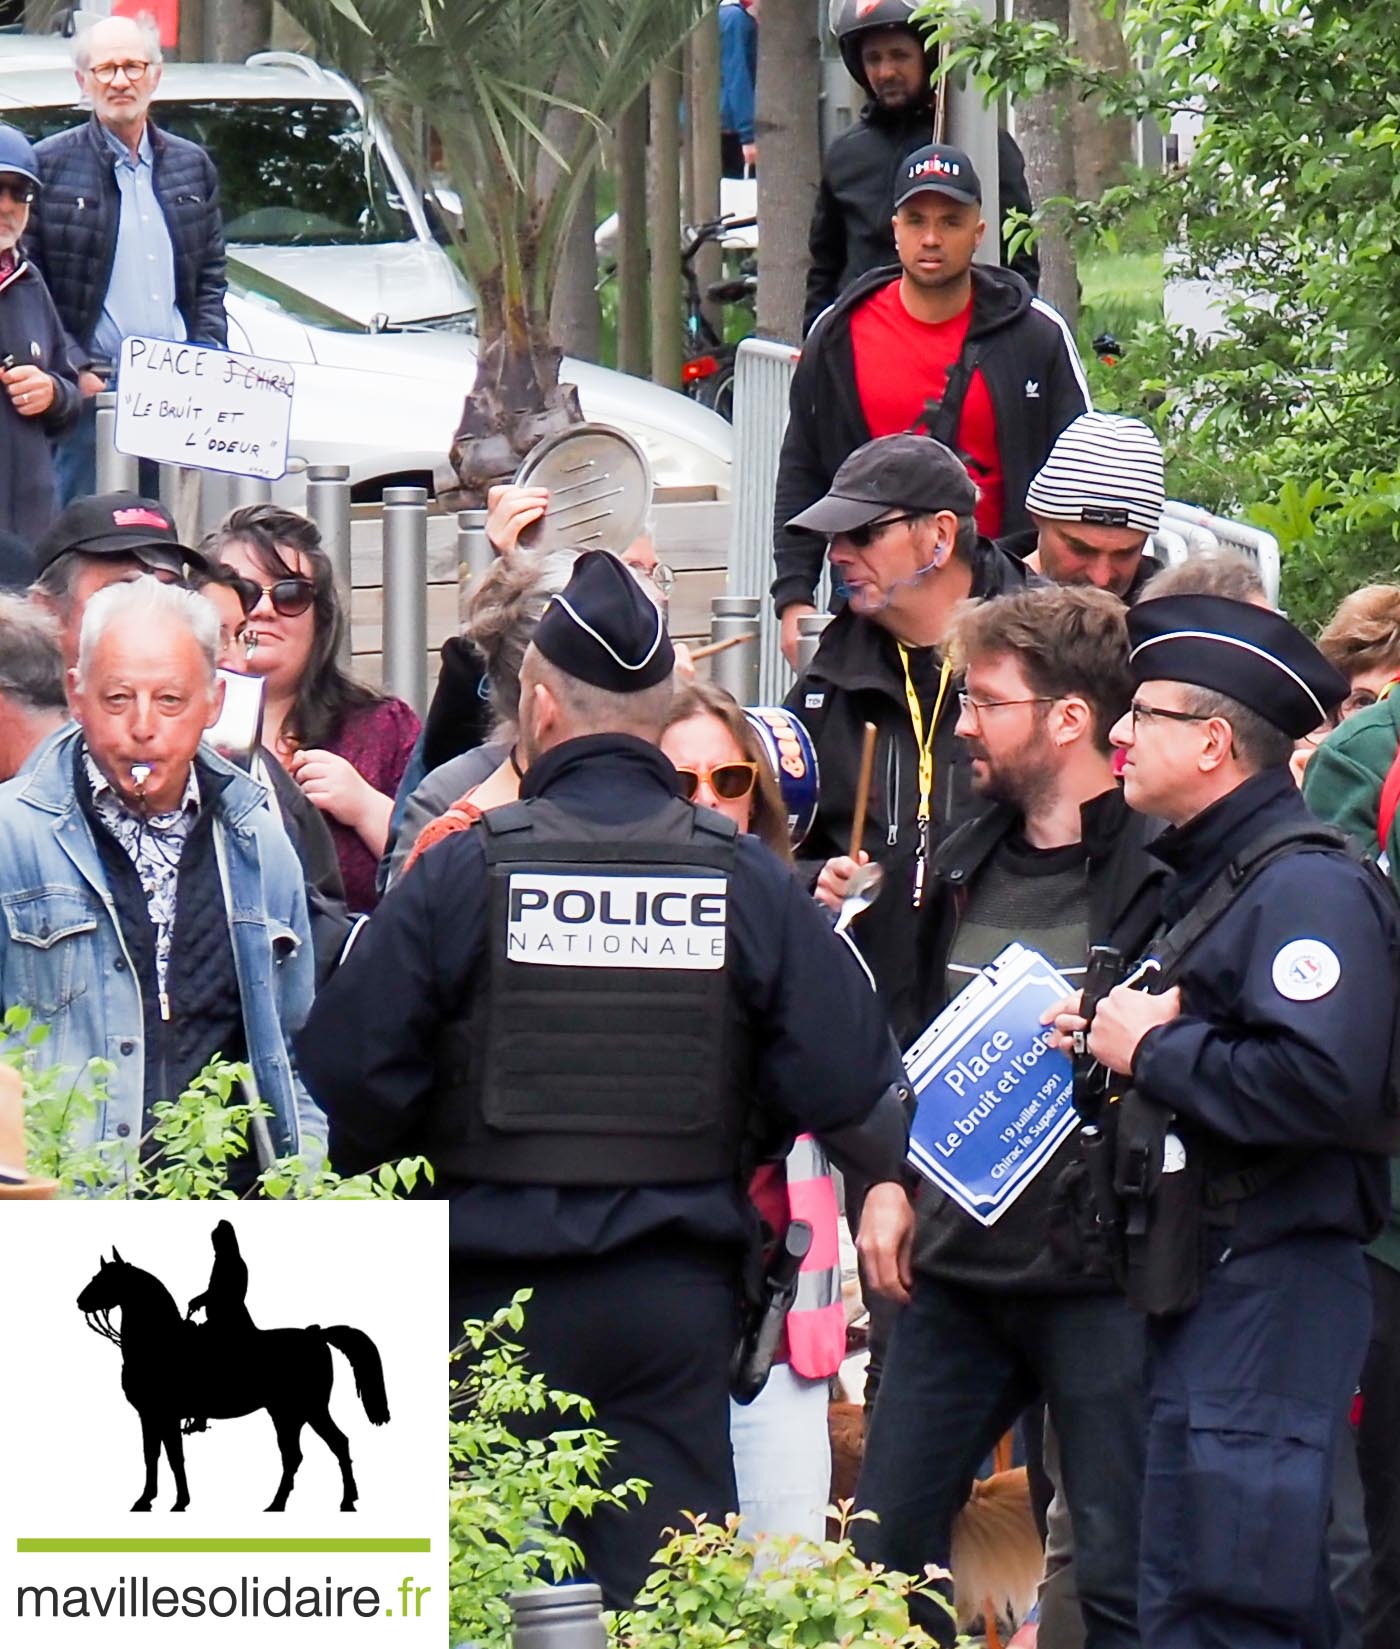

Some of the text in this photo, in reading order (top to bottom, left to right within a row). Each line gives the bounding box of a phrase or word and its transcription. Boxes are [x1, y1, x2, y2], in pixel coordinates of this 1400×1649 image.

[130, 339, 208, 376] PLACE
[217, 412, 245, 422] ET
[510, 888, 726, 926] POLICE
[509, 932, 724, 957] NATIONALE
[943, 1030, 1013, 1097] Place
[934, 1132, 963, 1158] Le
[953, 1090, 1002, 1136] bruit
[997, 1070, 1020, 1094] et
[1000, 1073, 1062, 1143] 19 juillet 1991
[991, 1144, 1024, 1179] Chirac
[1018, 1135, 1033, 1148] le
